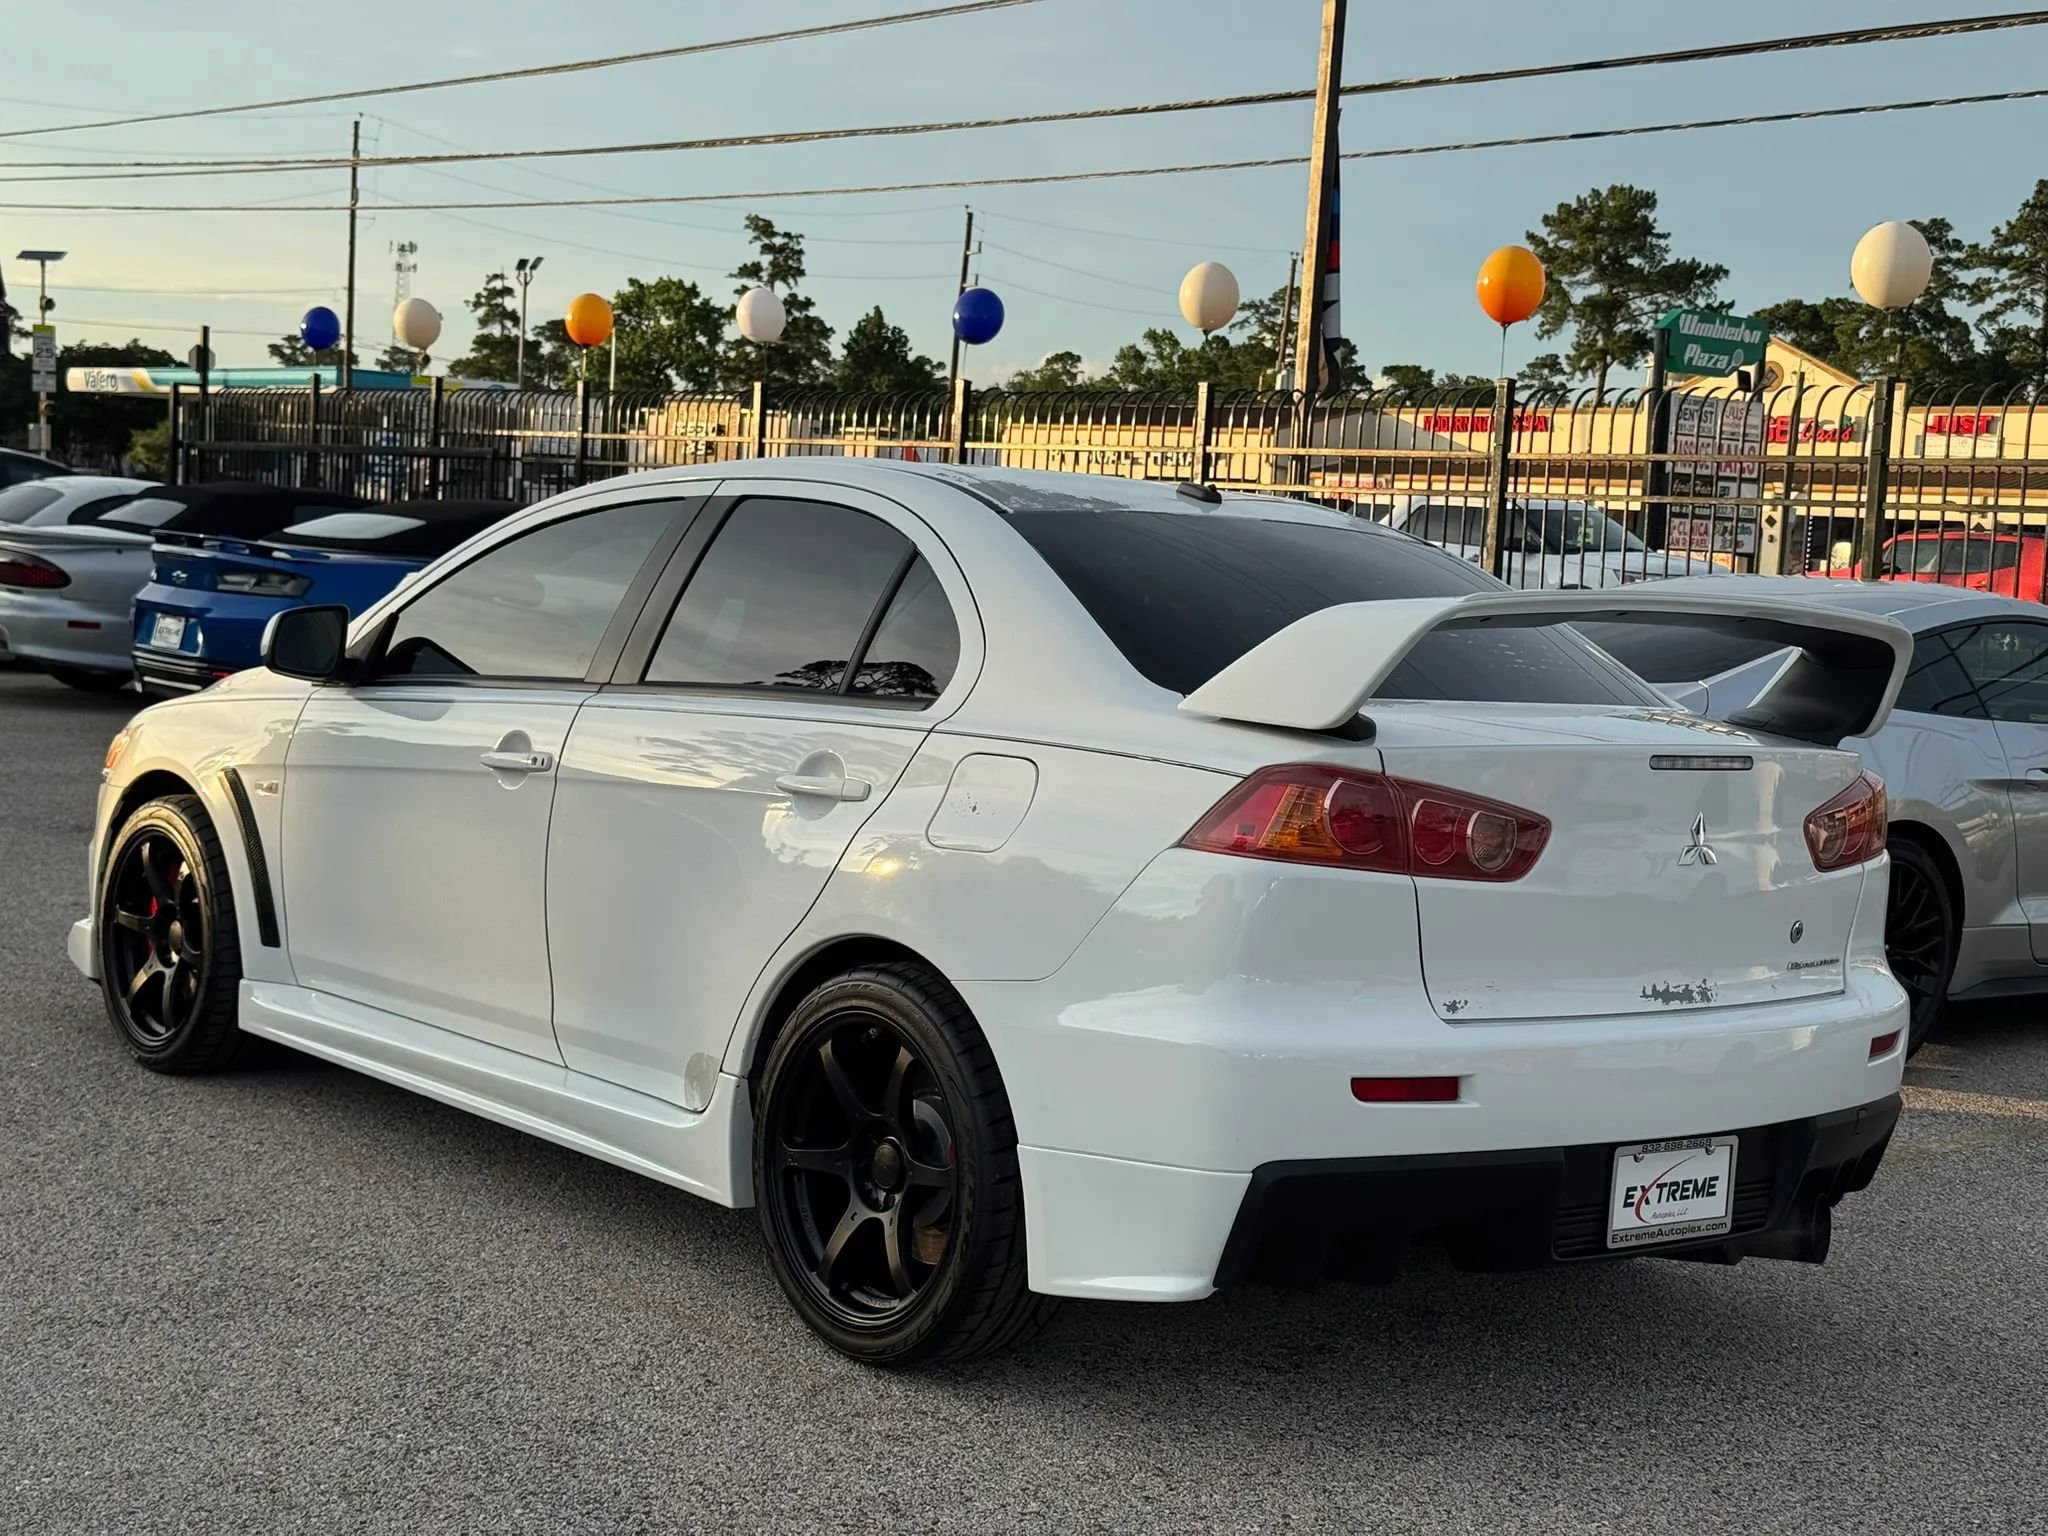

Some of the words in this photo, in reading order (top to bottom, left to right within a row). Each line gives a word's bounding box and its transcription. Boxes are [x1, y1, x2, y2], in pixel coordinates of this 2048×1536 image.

[1679, 313, 1762, 344] Wimbledon
[1684, 343, 1729, 370] Plaza
[84, 370, 119, 391] Valero
[1676, 406, 1714, 425] DENTST
[1926, 415, 1993, 435] JUST
[1622, 1176, 1720, 1209] EXTREME
[1611, 1221, 1727, 1245] ExtremeAutoplex.com
